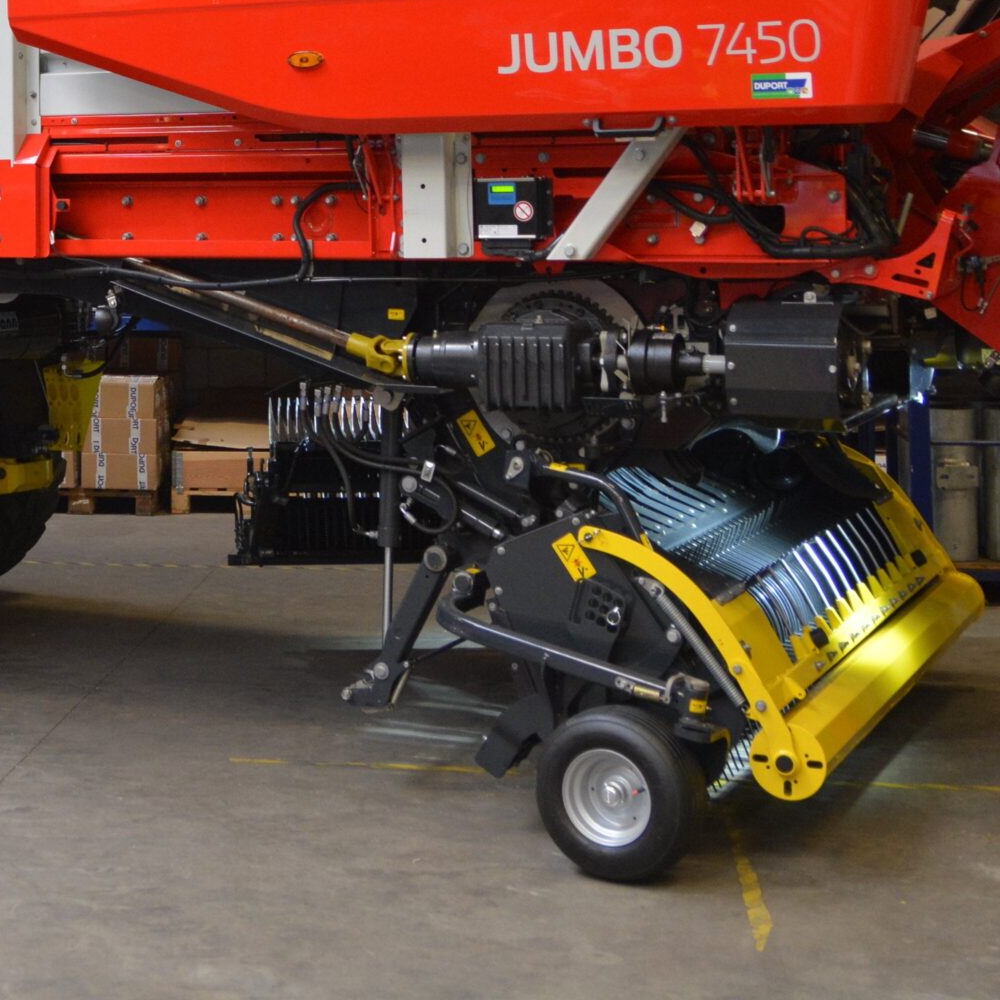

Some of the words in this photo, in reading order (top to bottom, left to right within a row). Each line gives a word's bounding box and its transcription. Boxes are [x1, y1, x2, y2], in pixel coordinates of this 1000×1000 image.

[498, 26, 682, 74] JUMBO
[696, 19, 821, 66] 7450
[753, 81, 788, 91] DUPORT
